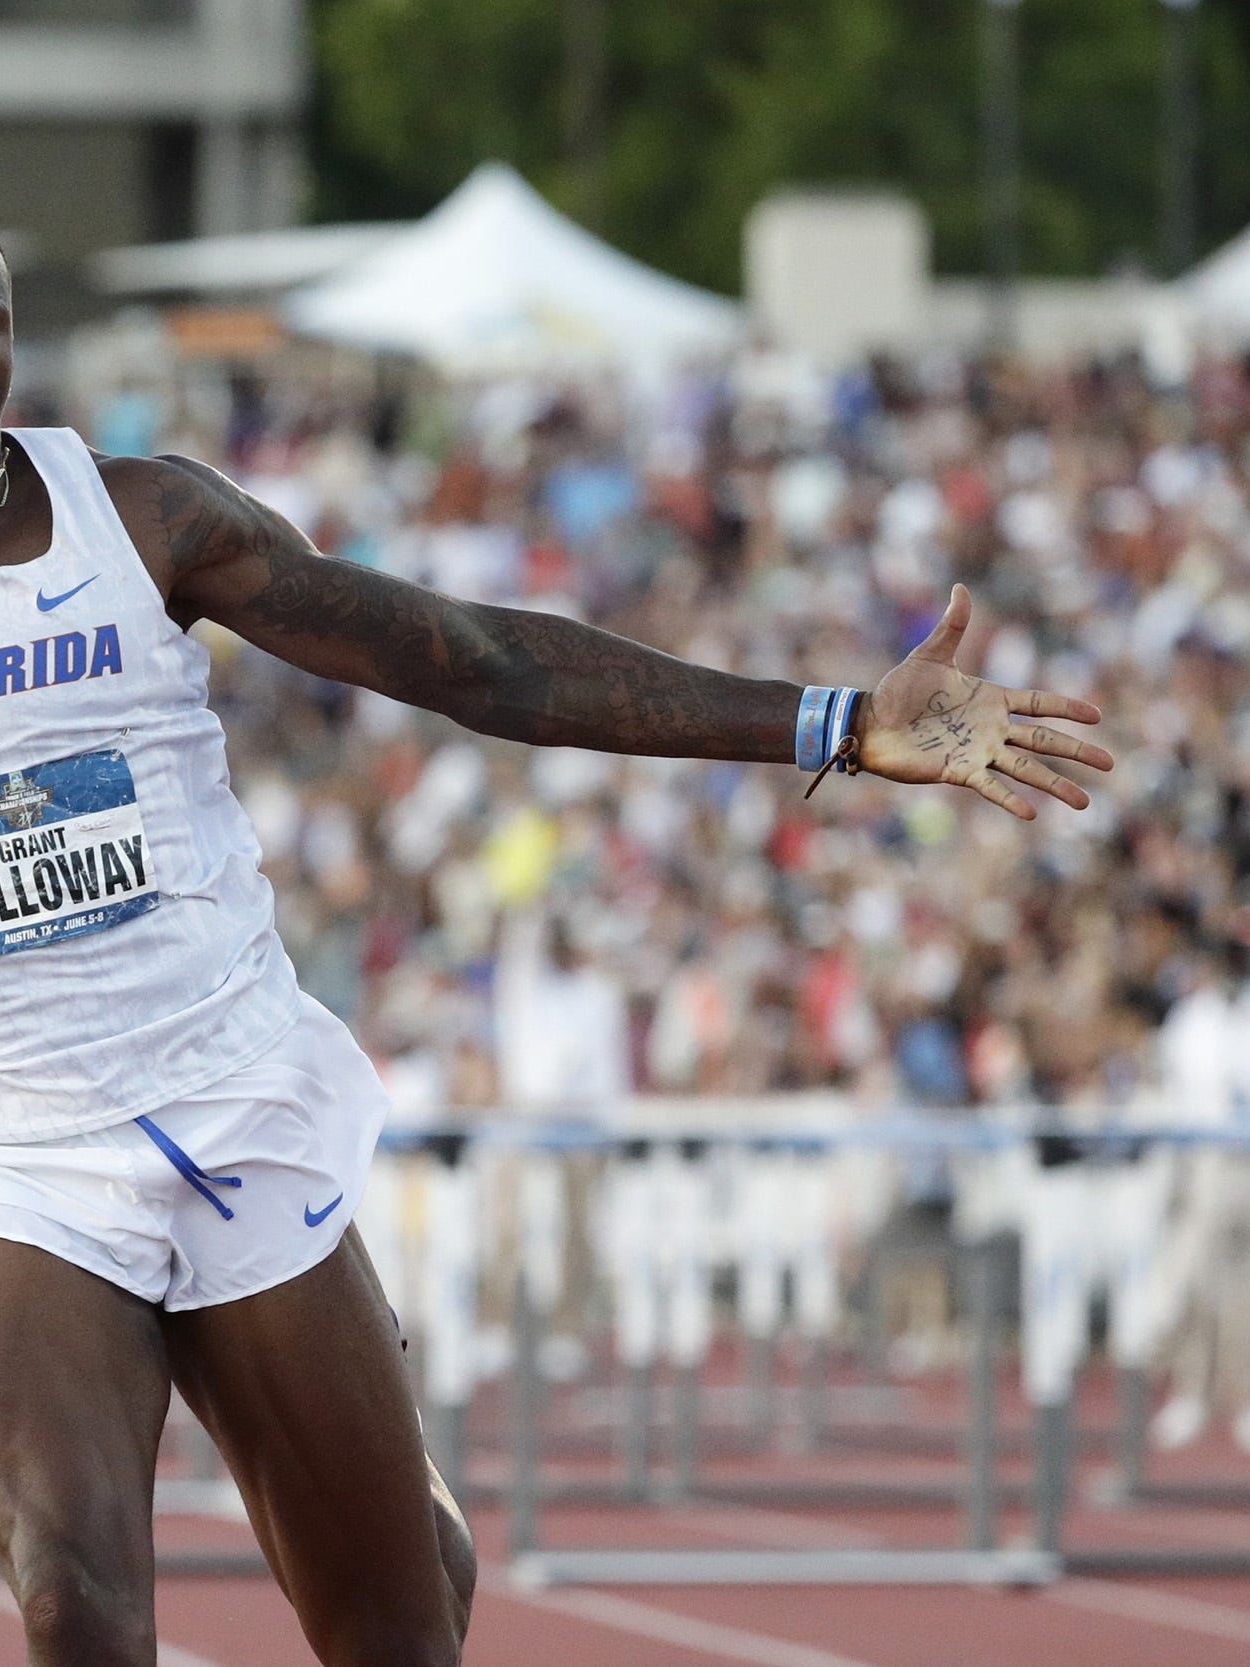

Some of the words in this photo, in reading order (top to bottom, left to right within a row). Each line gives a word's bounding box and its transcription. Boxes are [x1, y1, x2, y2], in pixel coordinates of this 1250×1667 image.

[4, 929, 39, 944] AUSTIN,
[40, 925, 53, 936] TX
[64, 916, 88, 930] JUNE
[88, 911, 104, 924] 5-8
